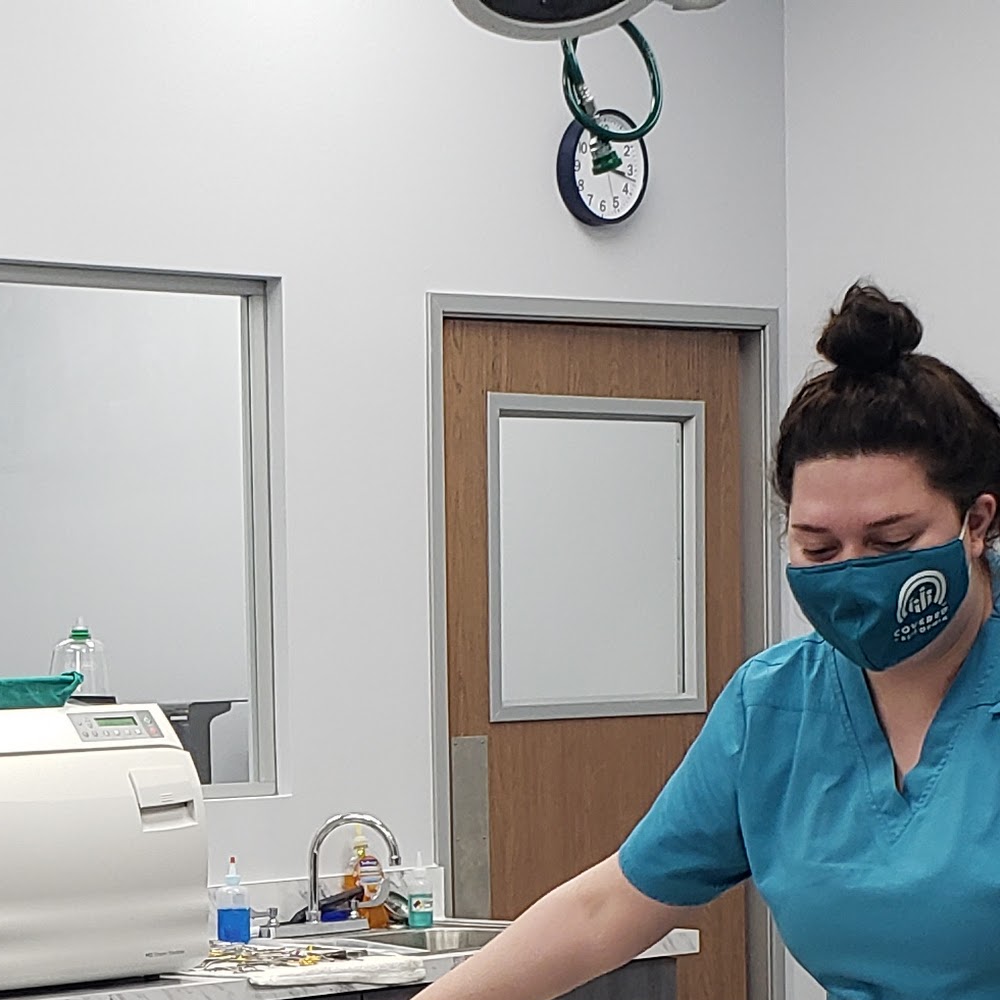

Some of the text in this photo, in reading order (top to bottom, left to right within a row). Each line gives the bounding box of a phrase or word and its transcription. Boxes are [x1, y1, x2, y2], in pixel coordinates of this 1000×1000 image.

[623, 144, 631, 157] 2
[574, 159, 581, 172] 9
[626, 163, 634, 176] 3
[578, 178, 585, 192] 8
[621, 182, 629, 195] 4
[586, 193, 594, 206] 7
[599, 199, 606, 212] 6
[612, 195, 620, 209] 5
[893, 605, 949, 638] COVERED
